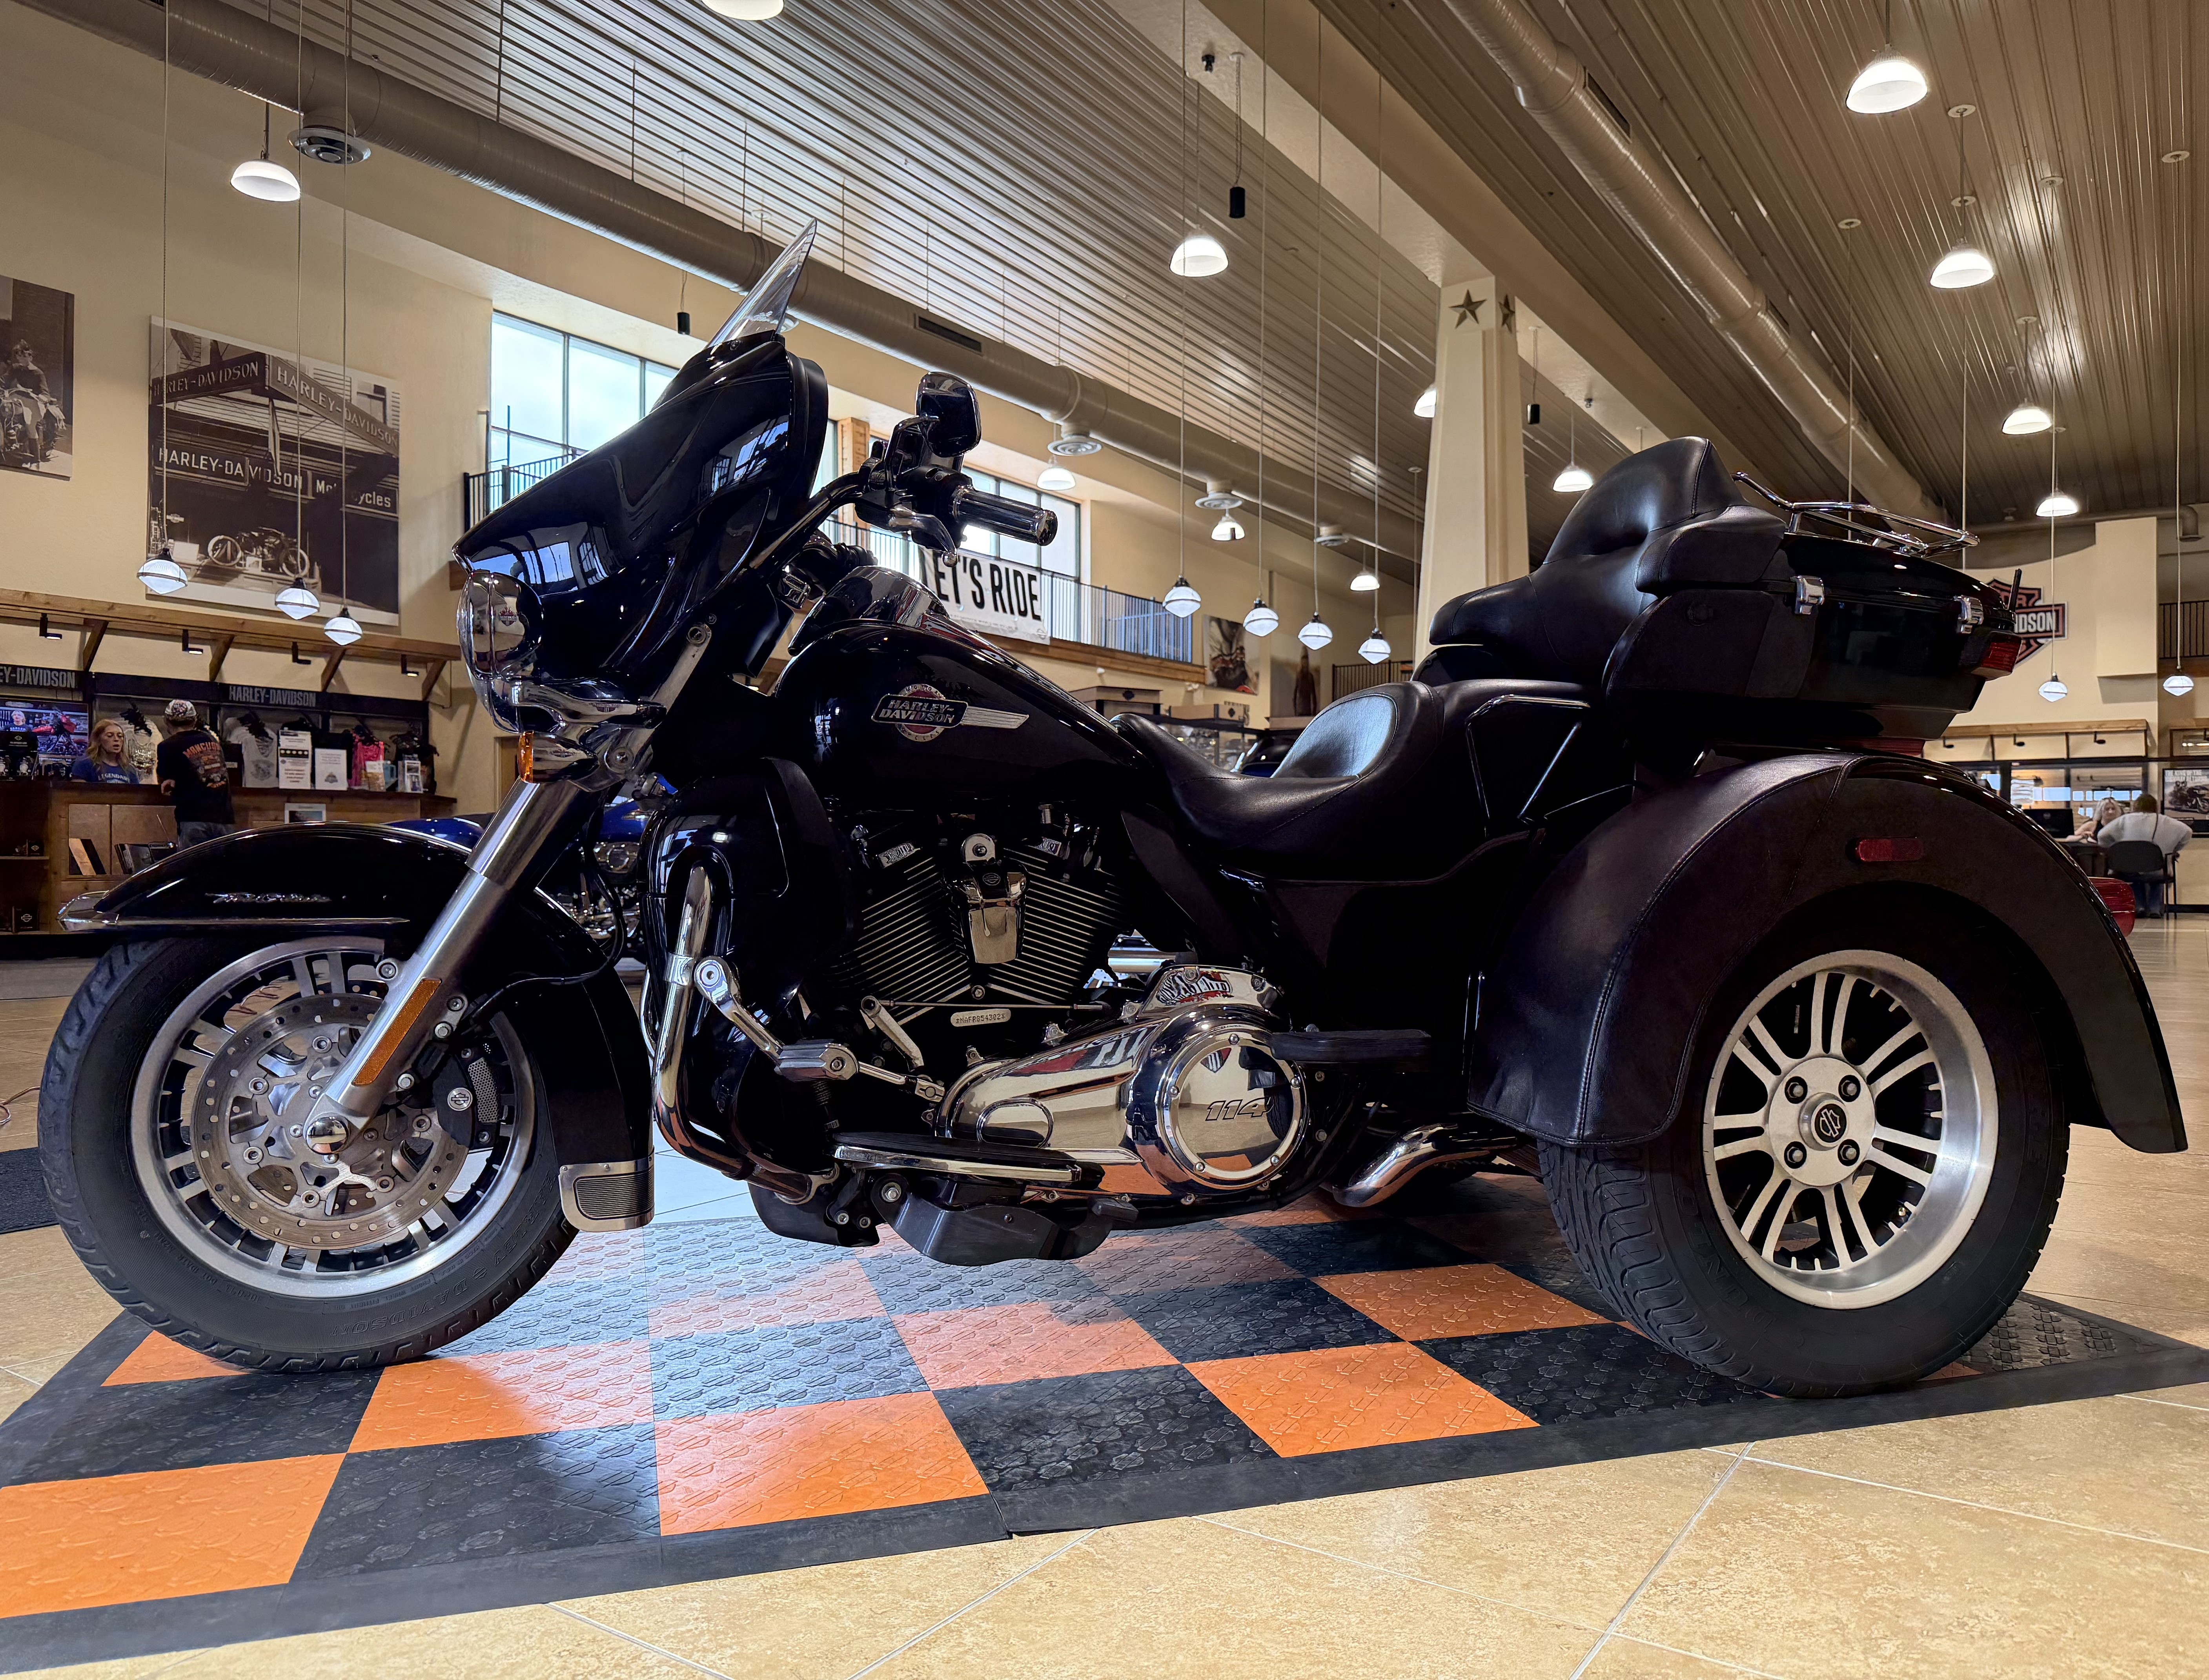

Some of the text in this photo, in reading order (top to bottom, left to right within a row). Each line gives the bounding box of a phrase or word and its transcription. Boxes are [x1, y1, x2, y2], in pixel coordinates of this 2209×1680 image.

[154, 361, 258, 396] HRLEY-DAVIDSON
[159, 447, 302, 489] HARLEY-DAVIDSON
[989, 563, 1042, 621] RIDE
[229, 685, 316, 706] HARLEY-DAVIDSON
[888, 700, 954, 713] HARLEY-
[879, 709, 954, 723] DAVIDSON
[1206, 1097, 1273, 1121] 114
